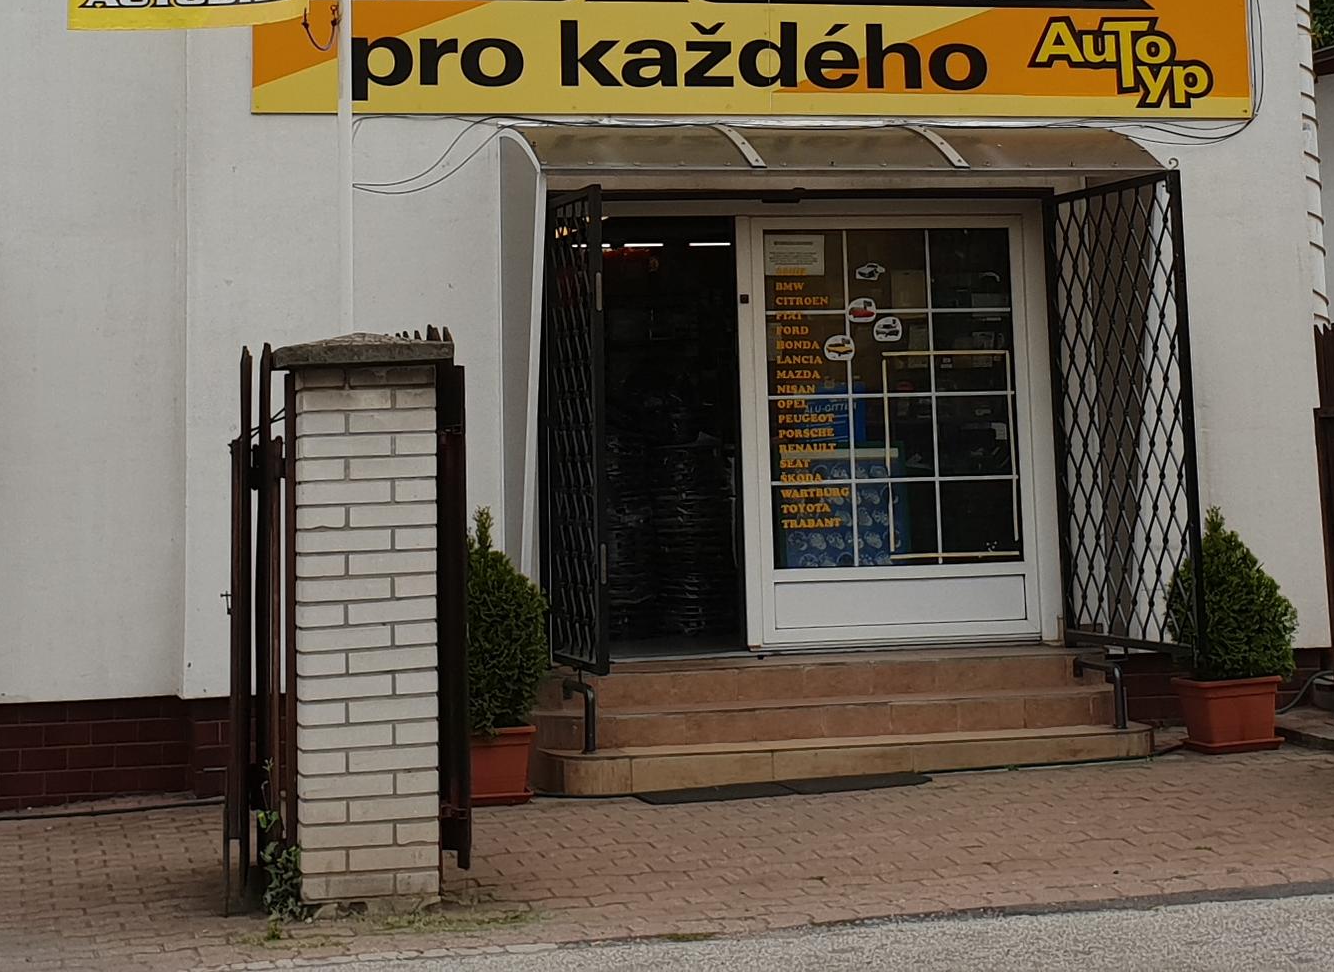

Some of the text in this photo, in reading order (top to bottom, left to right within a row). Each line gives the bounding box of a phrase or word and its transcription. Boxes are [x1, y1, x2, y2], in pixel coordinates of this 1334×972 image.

[351, 20, 988, 102] pro každého
[775, 282, 804, 291] BMW
[776, 326, 809, 335] FORD
[776, 340, 820, 350] HONDA
[776, 355, 823, 364] LANCIA
[776, 370, 821, 379] MAZDA
[776, 384, 816, 394] NISAN
[777, 399, 806, 408] OPEL
[778, 414, 835, 424] PEUGEOT
[778, 428, 835, 438] PORSCHE
[778, 443, 837, 453] RENAULT
[779, 459, 812, 468] SEAT
[780, 471, 823, 483] ŠKODA
[780, 487, 850, 498] WARTBURG
[780, 503, 832, 514] TOYOTA
[781, 517, 843, 529] TRABANT
